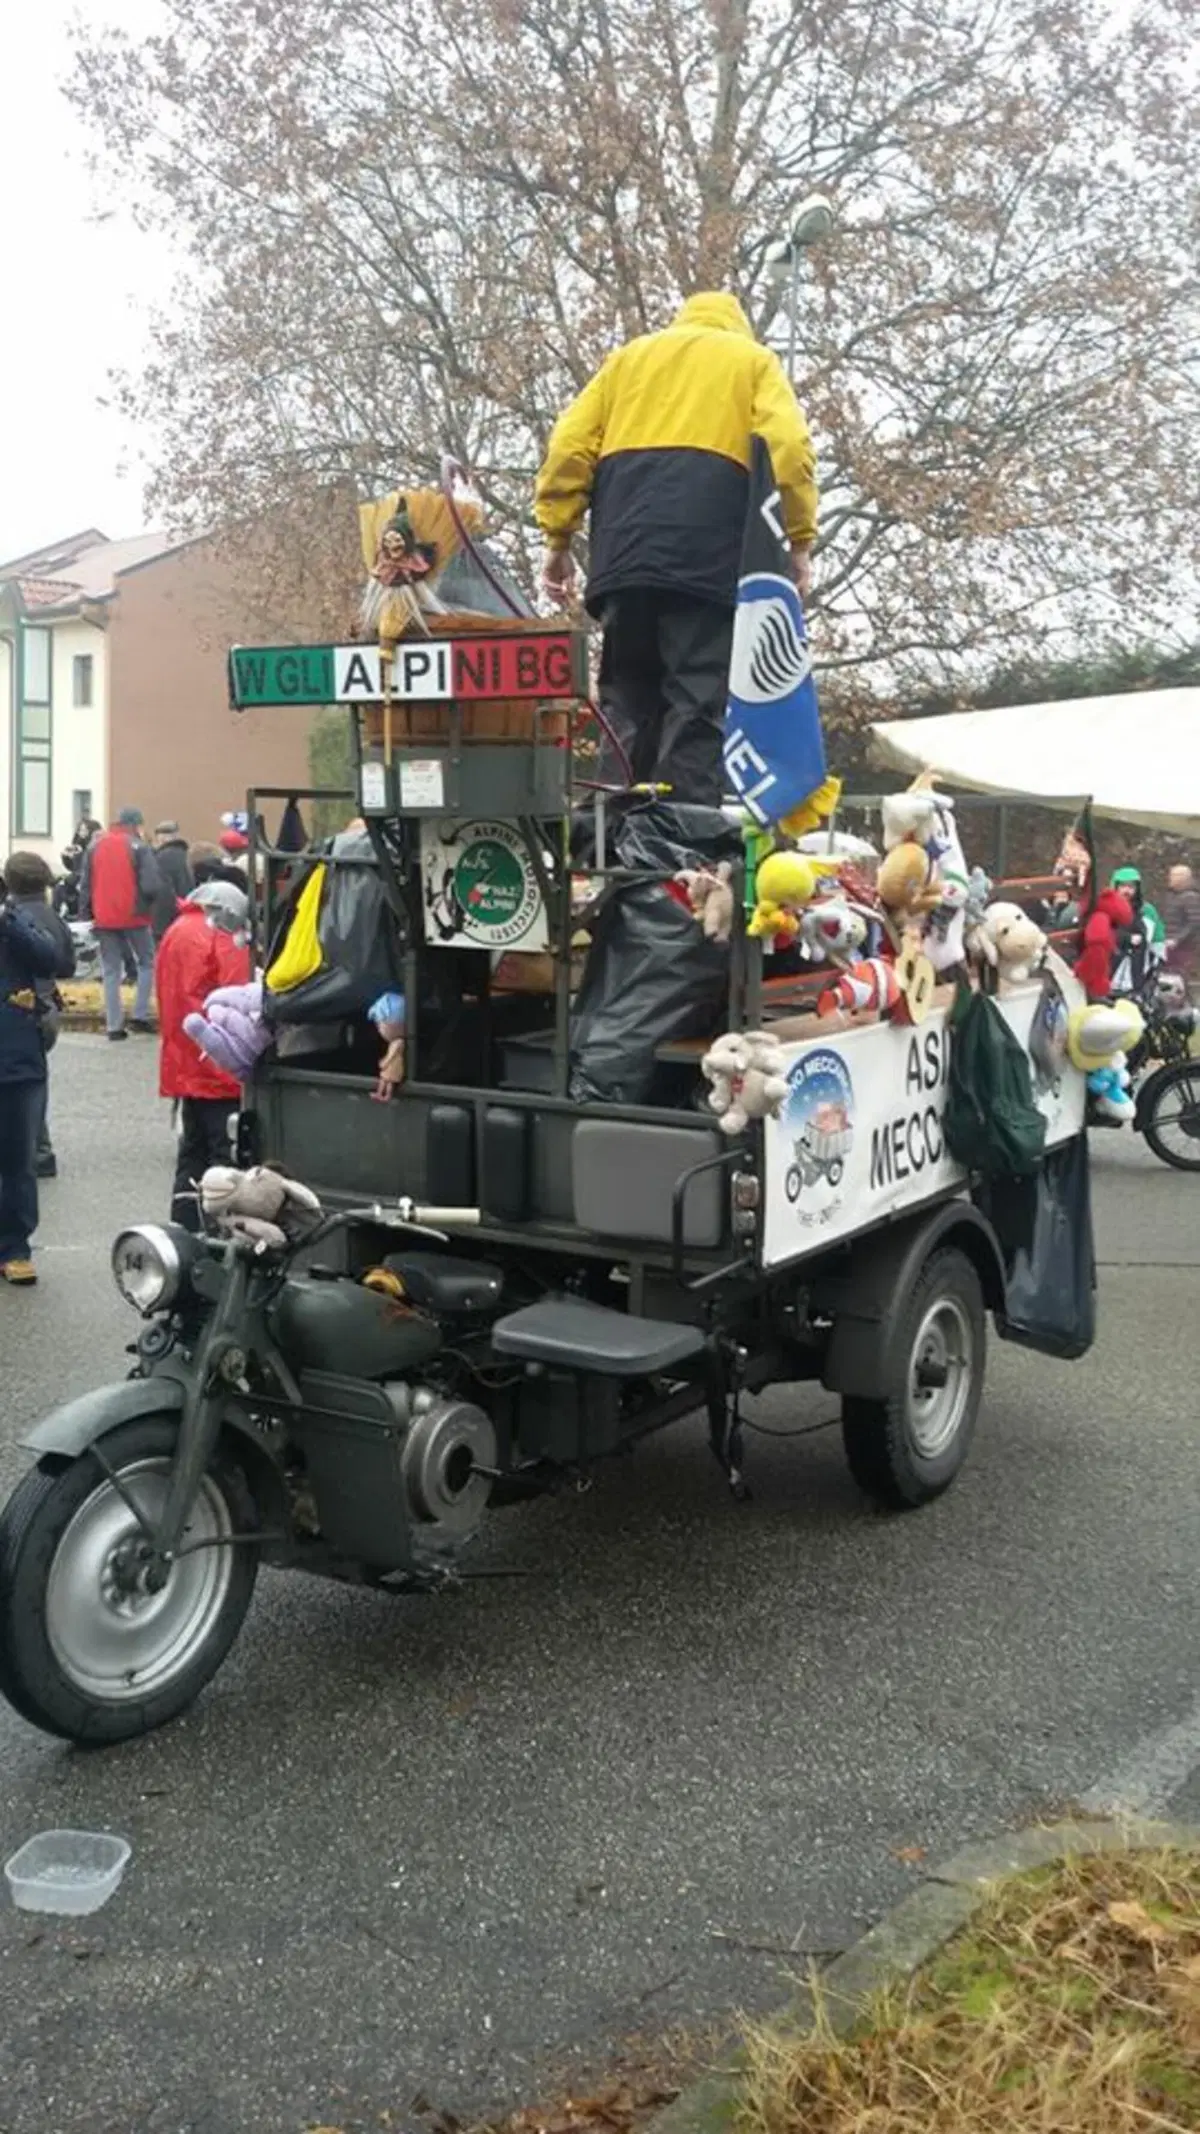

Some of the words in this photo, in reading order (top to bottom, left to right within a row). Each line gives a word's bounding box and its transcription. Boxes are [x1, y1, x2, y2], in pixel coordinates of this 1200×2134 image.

[238, 657, 266, 696] W
[275, 655, 333, 696] GLI
[342, 647, 499, 694] ALPINI
[516, 645, 572, 688] BG
[906, 1030, 952, 1095] ASI
[869, 1105, 943, 1190] MECC
